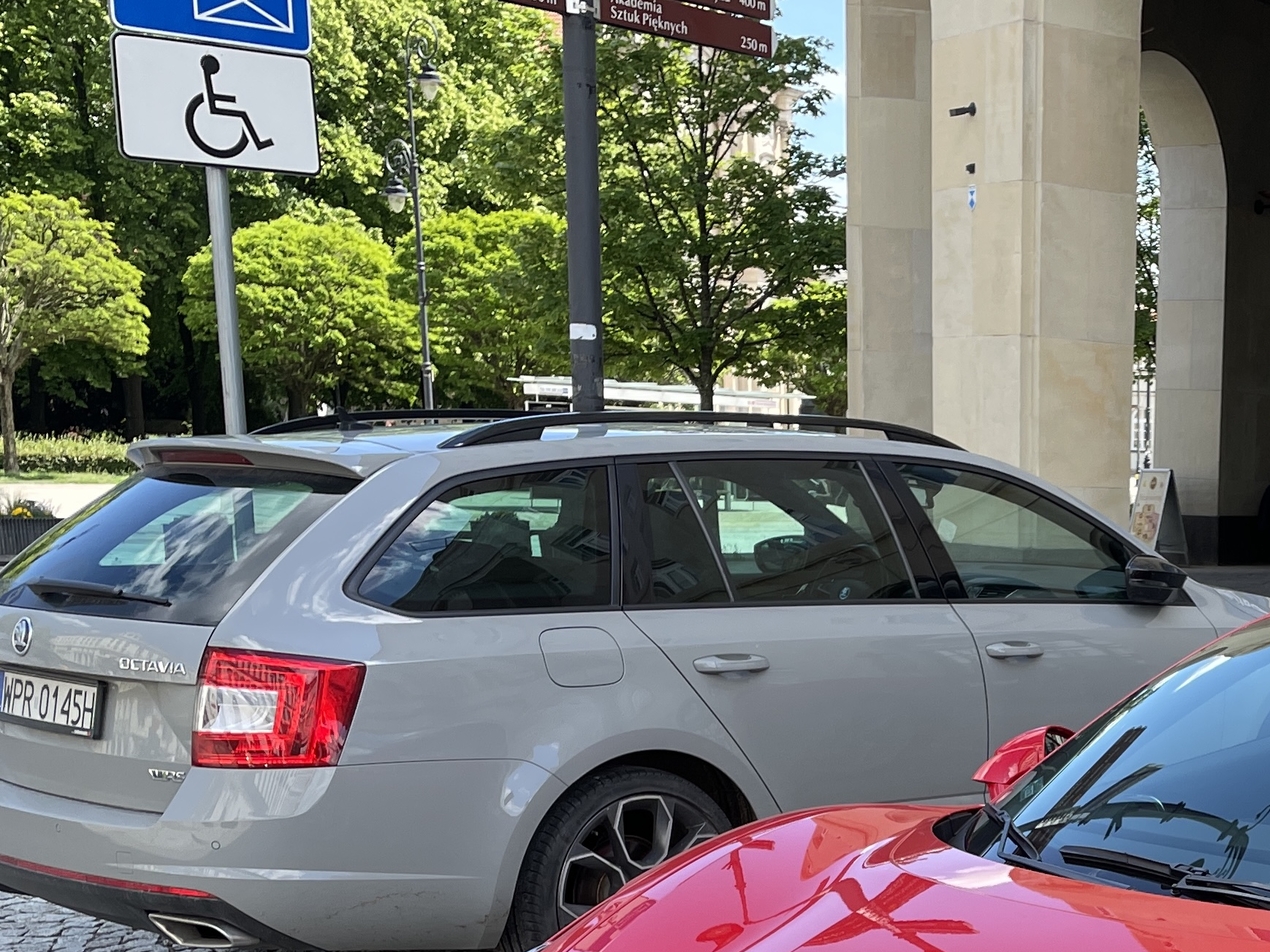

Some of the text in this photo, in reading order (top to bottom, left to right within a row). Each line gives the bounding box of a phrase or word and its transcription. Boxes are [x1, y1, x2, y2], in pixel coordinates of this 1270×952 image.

[610, 6, 688, 35] Sztuk Pięknych
[740, 36, 768, 53] 250 m
[119, 657, 187, 676] OCTAVIA
[3, 676, 96, 730] WPR 0145H
